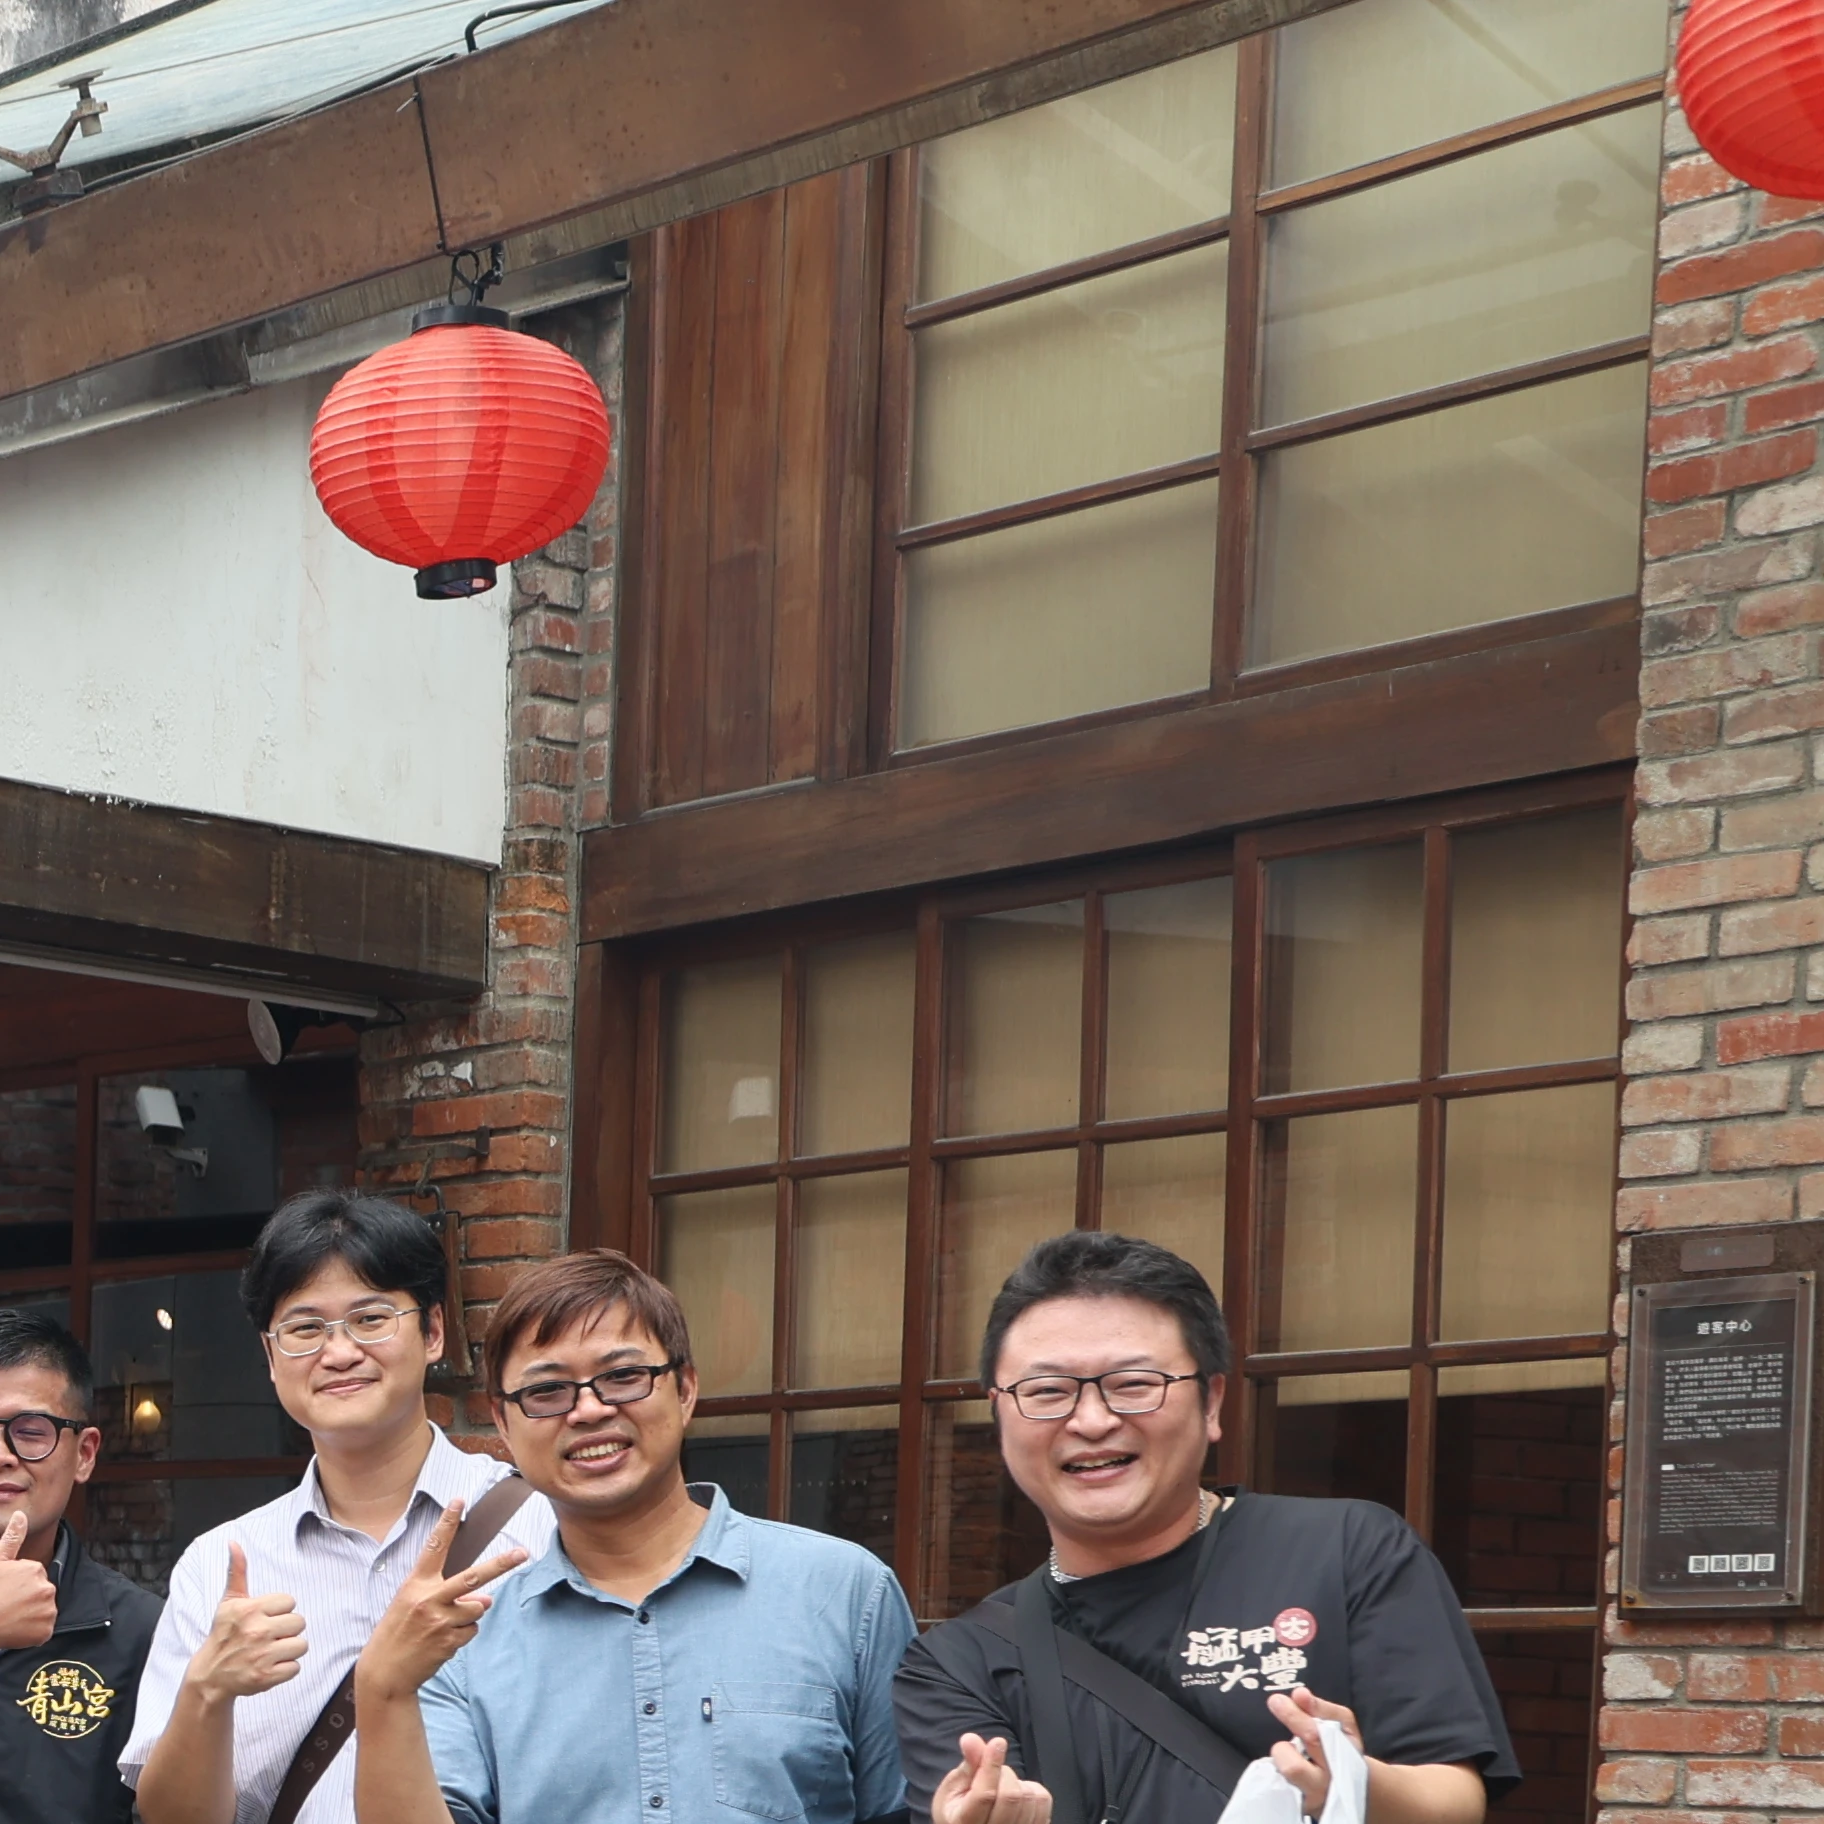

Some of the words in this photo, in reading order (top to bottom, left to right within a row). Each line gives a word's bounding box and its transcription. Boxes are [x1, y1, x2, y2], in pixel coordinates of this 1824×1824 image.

[1696, 1318, 1752, 1335] 遊客中心
[15, 1670, 115, 1725] 青山宮
